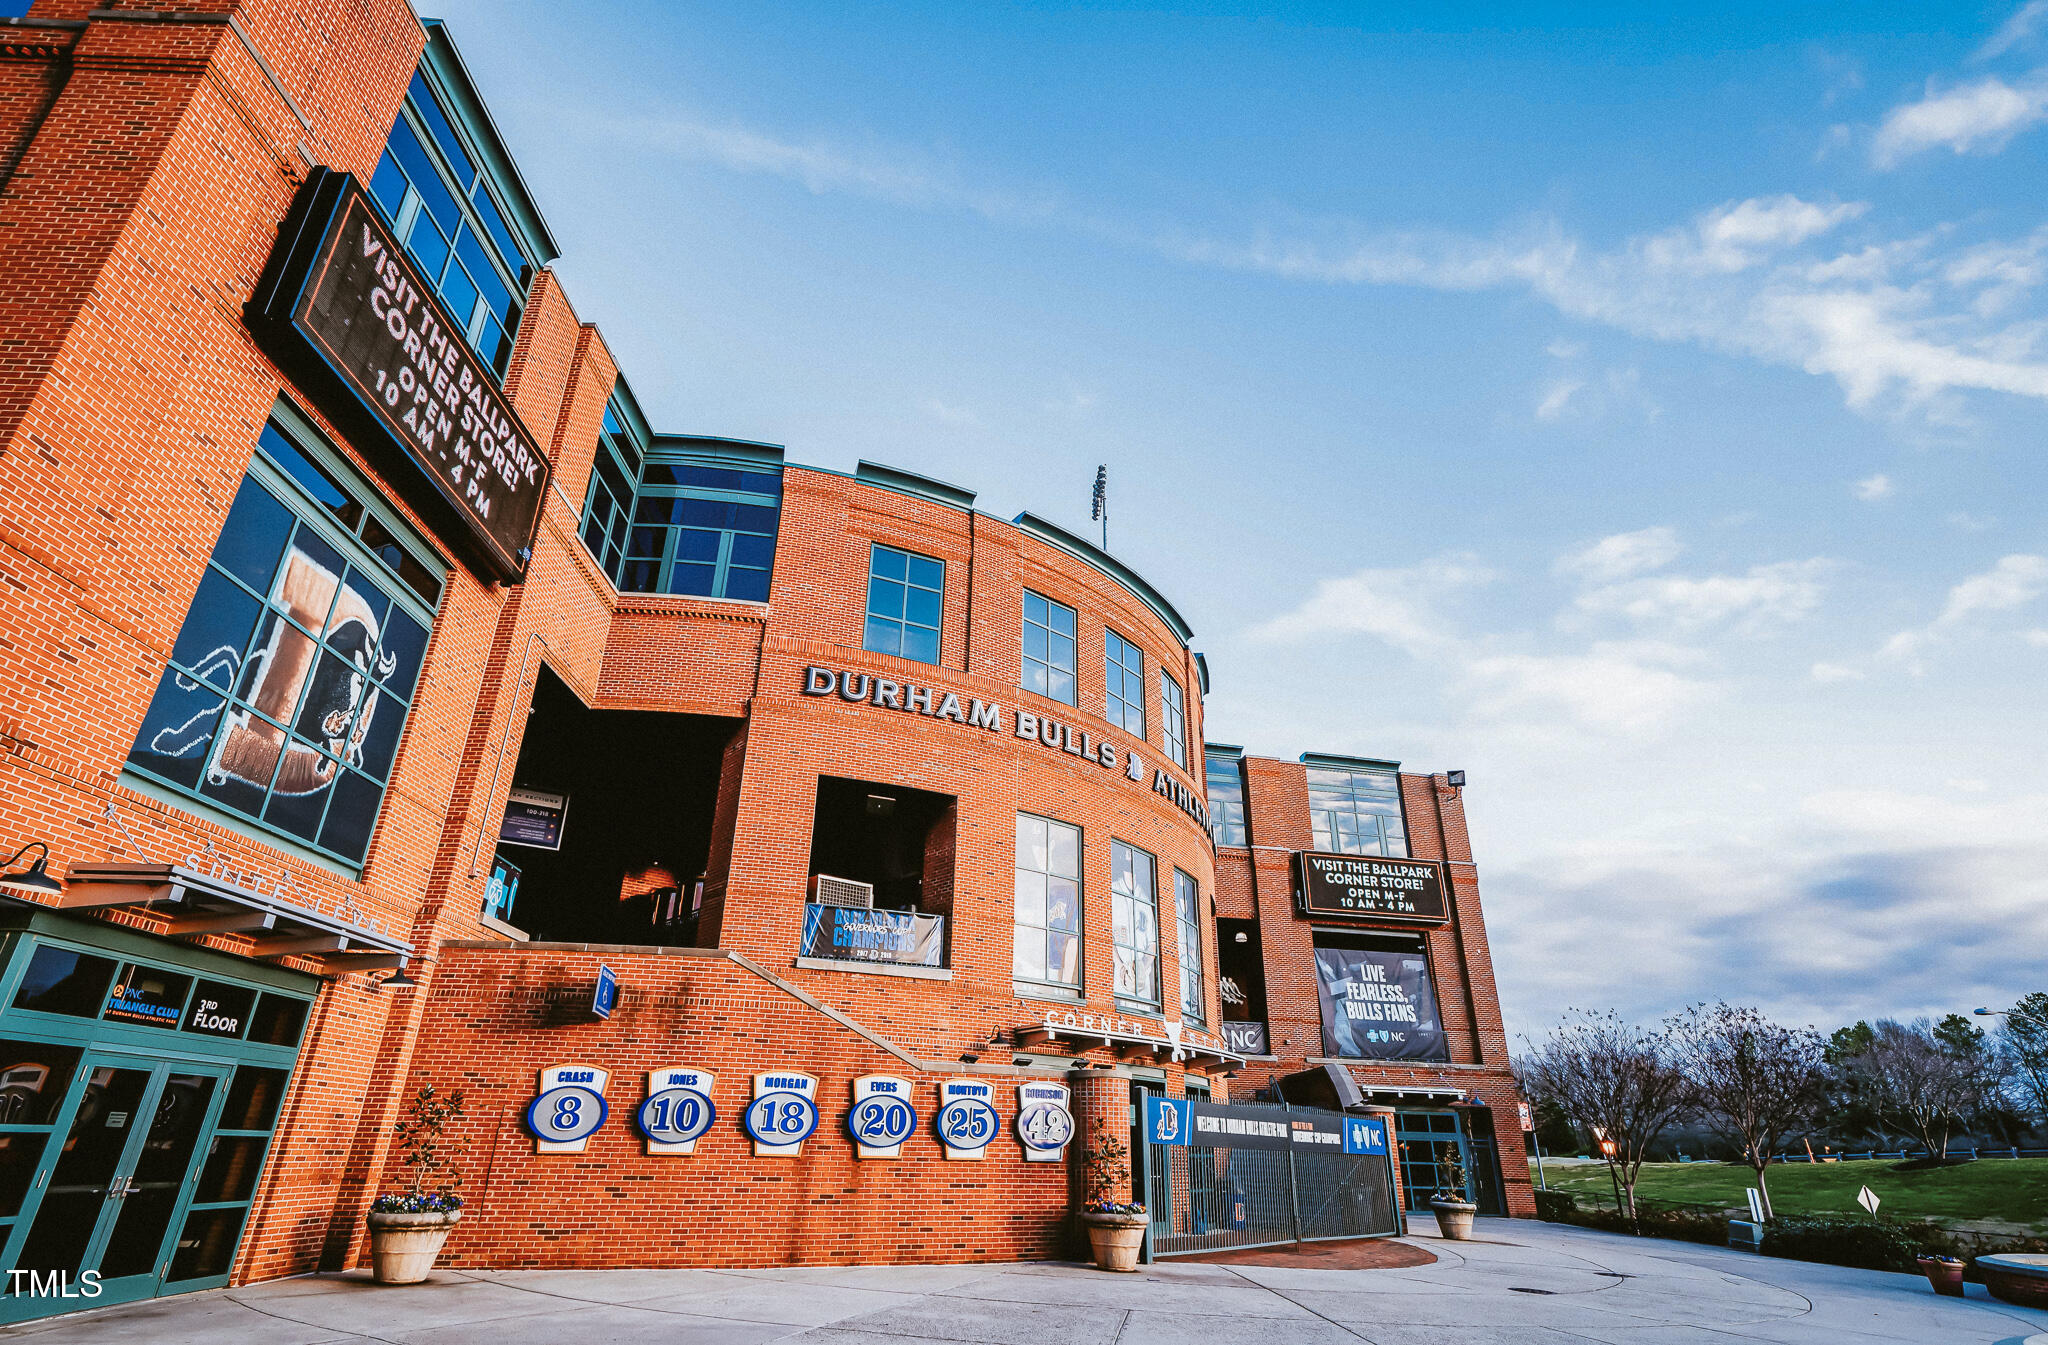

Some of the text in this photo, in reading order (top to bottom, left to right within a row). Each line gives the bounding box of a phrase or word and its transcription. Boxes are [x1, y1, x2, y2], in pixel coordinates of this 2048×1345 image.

[363, 222, 539, 486] VISIT THE BALLPARK
[370, 286, 520, 492] CORNER STORE!
[398, 365, 488, 481] OPEN M-F
[375, 369, 400, 406] 10
[402, 406, 435, 452] AM
[450, 464, 464, 485] 4
[466, 477, 491, 519] PM
[804, 666, 1001, 732] DURHAM
[1015, 709, 1118, 770] BULLS
[1312, 859, 1433, 879] VISIT THE BALLPARK
[1325, 873, 1424, 891] CORNER STORE!
[1341, 897, 1353, 908] 10
[1358, 899, 1375, 909] AM
[1387, 901, 1395, 911] 4
[1397, 901, 1415, 912] PM
[1348, 888, 1405, 900] OPEN M-F
[833, 926, 916, 953] CHAMPIONS
[1360, 964, 1387, 983] LIVE
[123, 987, 145, 1000] PNC
[1346, 982, 1409, 1004] FEARLESS,
[108, 998, 180, 1019] TRIANGLE CLUB
[197, 999, 219, 1014] 3RD
[1345, 1001, 1417, 1023] BULLS FANS
[192, 1012, 238, 1033] FLOOR
[1045, 1011, 1143, 1036] CORNER
[1231, 1029, 1257, 1049] NC
[1391, 1032, 1406, 1042] NC
[557, 1071, 594, 1083] CRASH
[667, 1073, 698, 1086] JONES
[764, 1077, 808, 1090] MORGAN
[870, 1081, 898, 1093] EVERS
[1025, 1088, 1064, 1100] ROBINSON
[551, 1095, 584, 1131] 8
[651, 1096, 703, 1134] 10
[758, 1100, 805, 1136] 18
[861, 1102, 908, 1138] 20
[948, 1107, 988, 1139] 25
[1027, 1109, 1066, 1142] 42
[1370, 1129, 1382, 1147] NC
